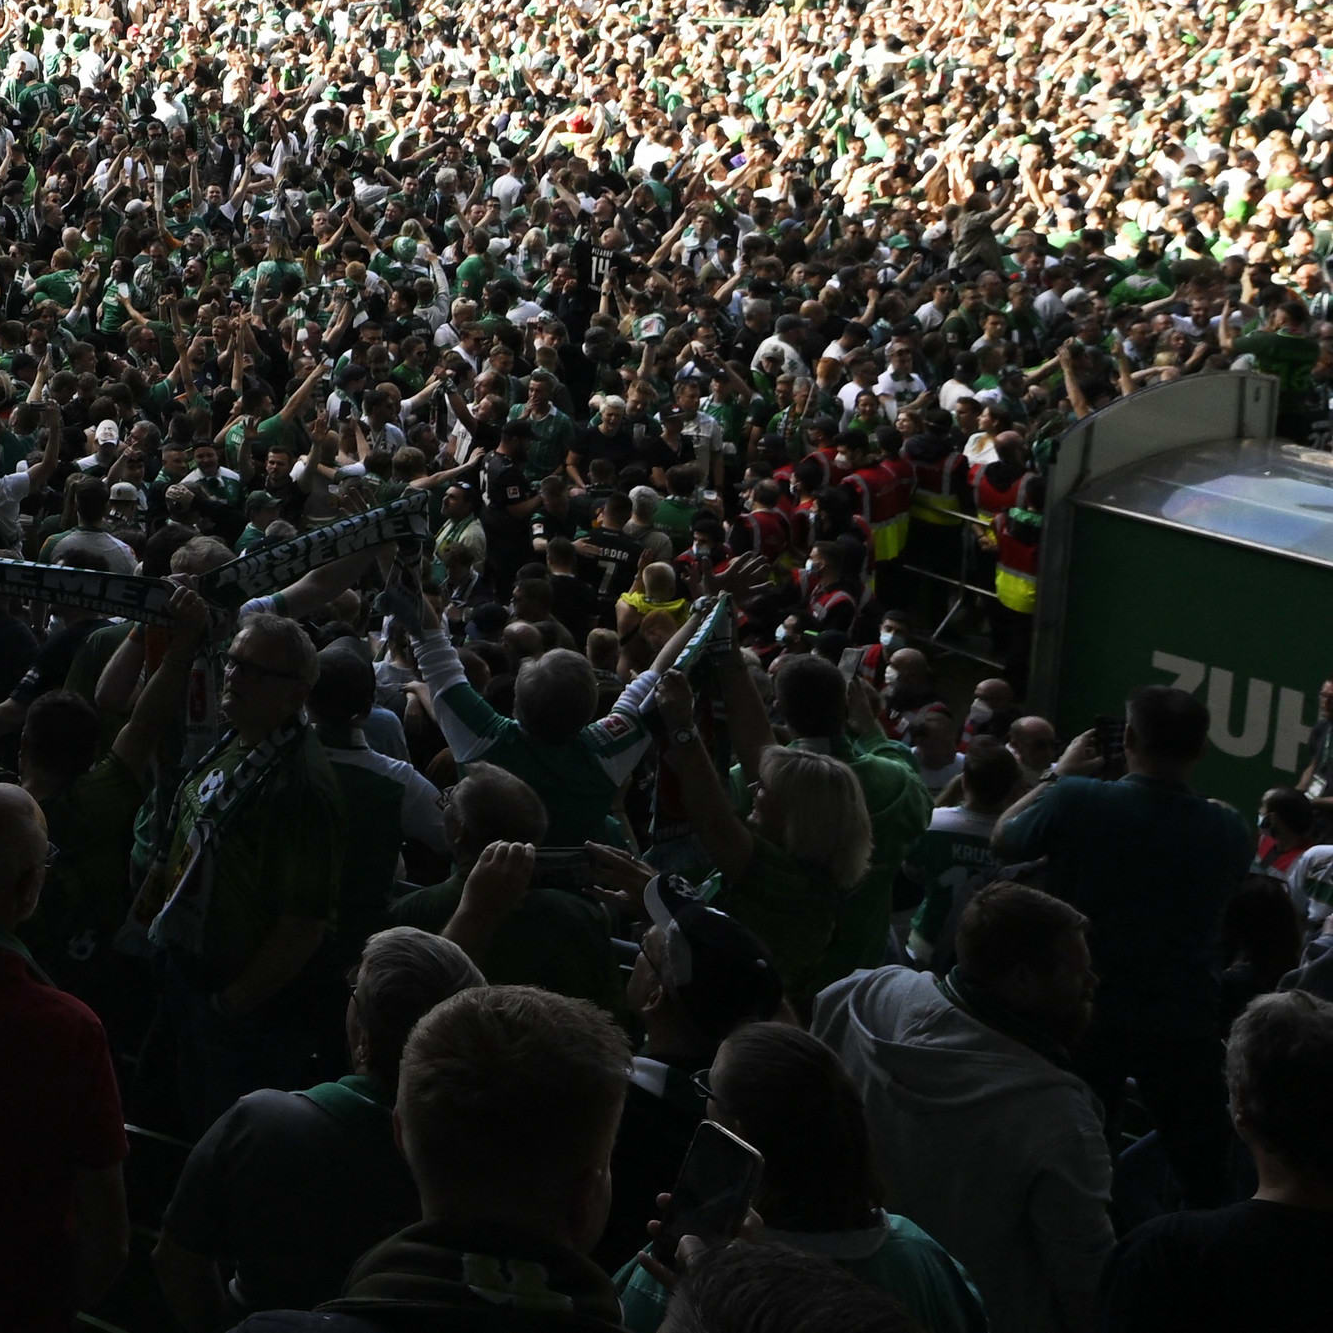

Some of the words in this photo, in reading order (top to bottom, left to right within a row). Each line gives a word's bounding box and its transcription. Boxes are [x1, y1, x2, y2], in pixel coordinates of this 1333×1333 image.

[600, 548, 629, 562] ERDER
[597, 560, 616, 594] 7
[953, 843, 994, 864] KRUS
